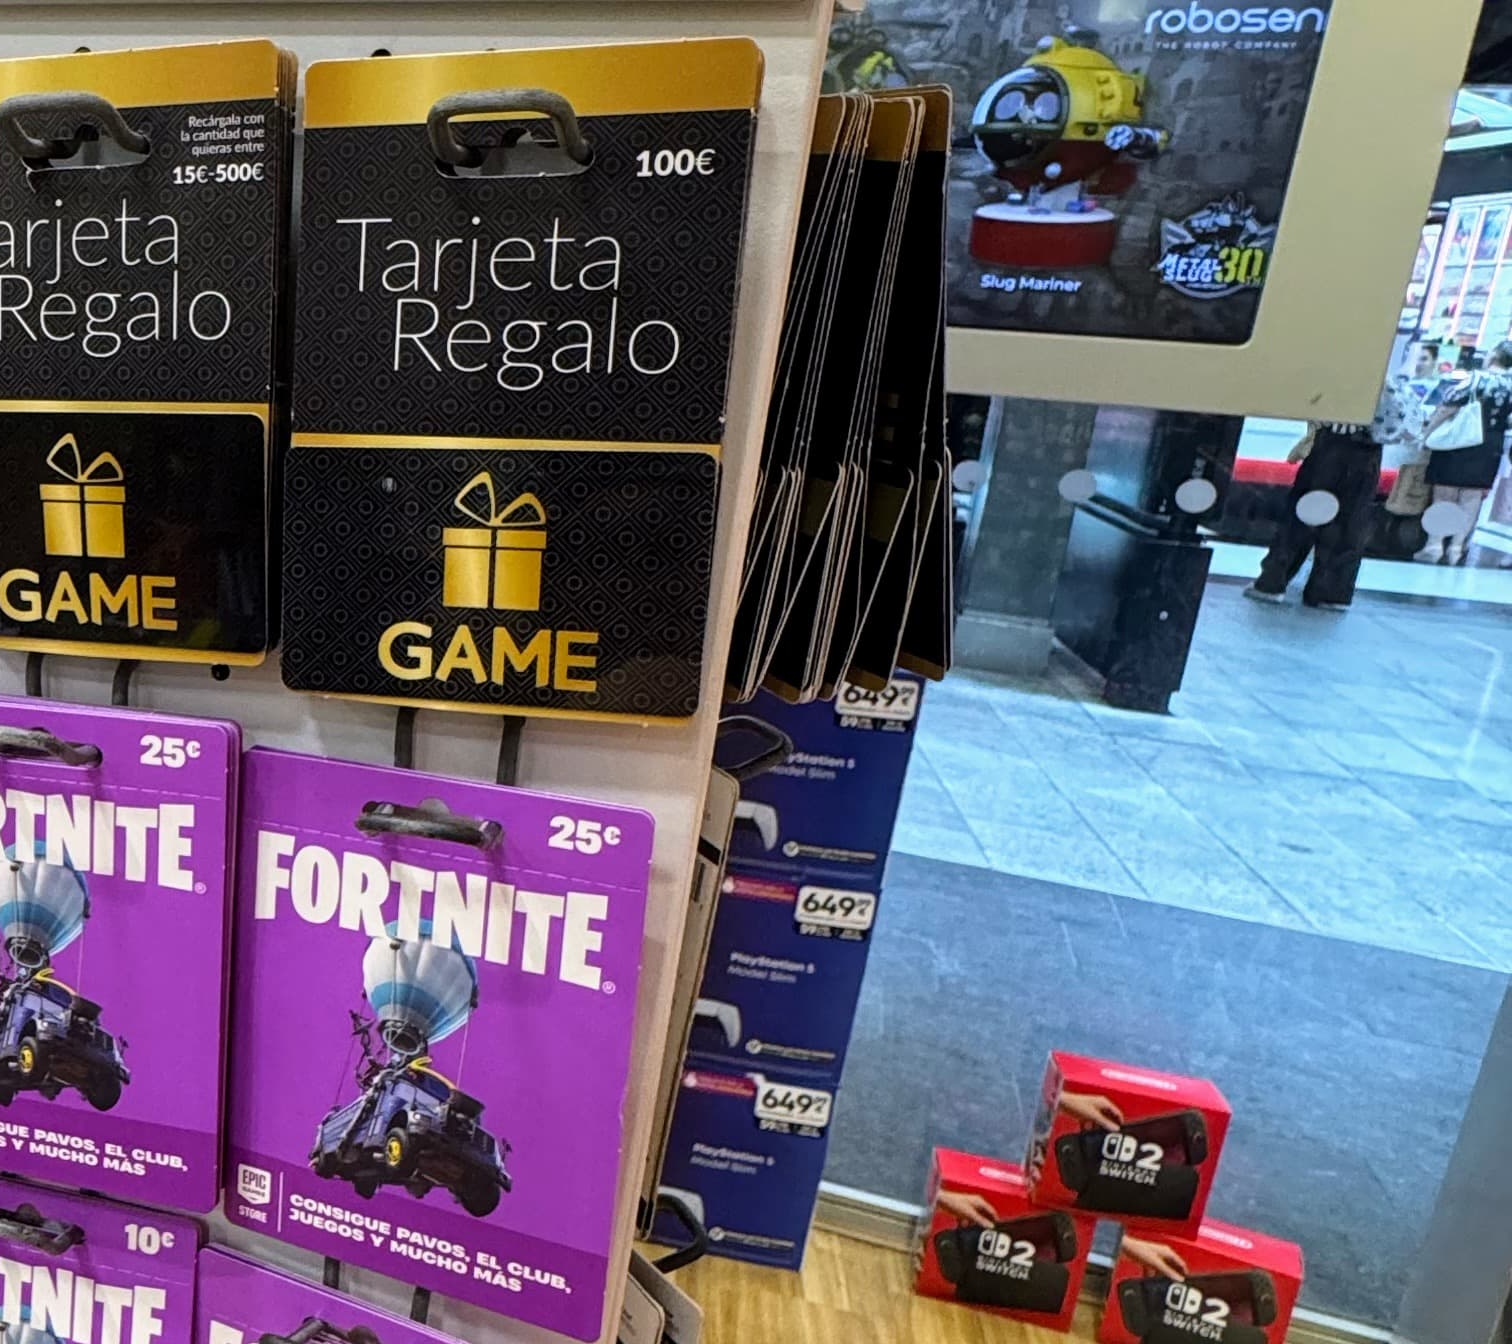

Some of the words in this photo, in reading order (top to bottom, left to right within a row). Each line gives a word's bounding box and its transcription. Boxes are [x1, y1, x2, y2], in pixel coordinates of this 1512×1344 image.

[1144, 1, 1324, 34] robosen
[181, 130, 190, 141] la
[193, 128, 240, 141] cantidad
[243, 129, 264, 138] que
[189, 113, 240, 128] Recárgala
[244, 115, 264, 124] con
[192, 144, 232, 156] quieras
[235, 142, 264, 152] entre
[636, 150, 714, 178] 100€
[337, 216, 621, 309] Tarjeta
[981, 275, 1016, 292] Slug
[1019, 277, 1082, 291] Mariner
[393, 299, 681, 390] Regalo
[378, 622, 600, 692] GAME
[256, 830, 608, 990] FORTNITE
[12, 1138, 24, 1150] Y
[29, 1140, 98, 1166] MUCHO
[102, 1155, 146, 1176] MÁS
[34, 1128, 100, 1154] PAVOS,
[104, 1143, 128, 1157] EL
[131, 1148, 188, 1172] CLUB,
[242, 1168, 266, 1188] EPIC
[289, 1194, 391, 1235] CONSIGUE
[396, 1227, 471, 1262] PAVOS,
[475, 1252, 501, 1270] EL
[506, 1260, 572, 1294] CLUB,
[289, 1208, 365, 1242] JUEGOS
[370, 1233, 384, 1248] Y
[390, 1240, 467, 1275] MUCHO
[473, 1266, 522, 1292] MÁS
